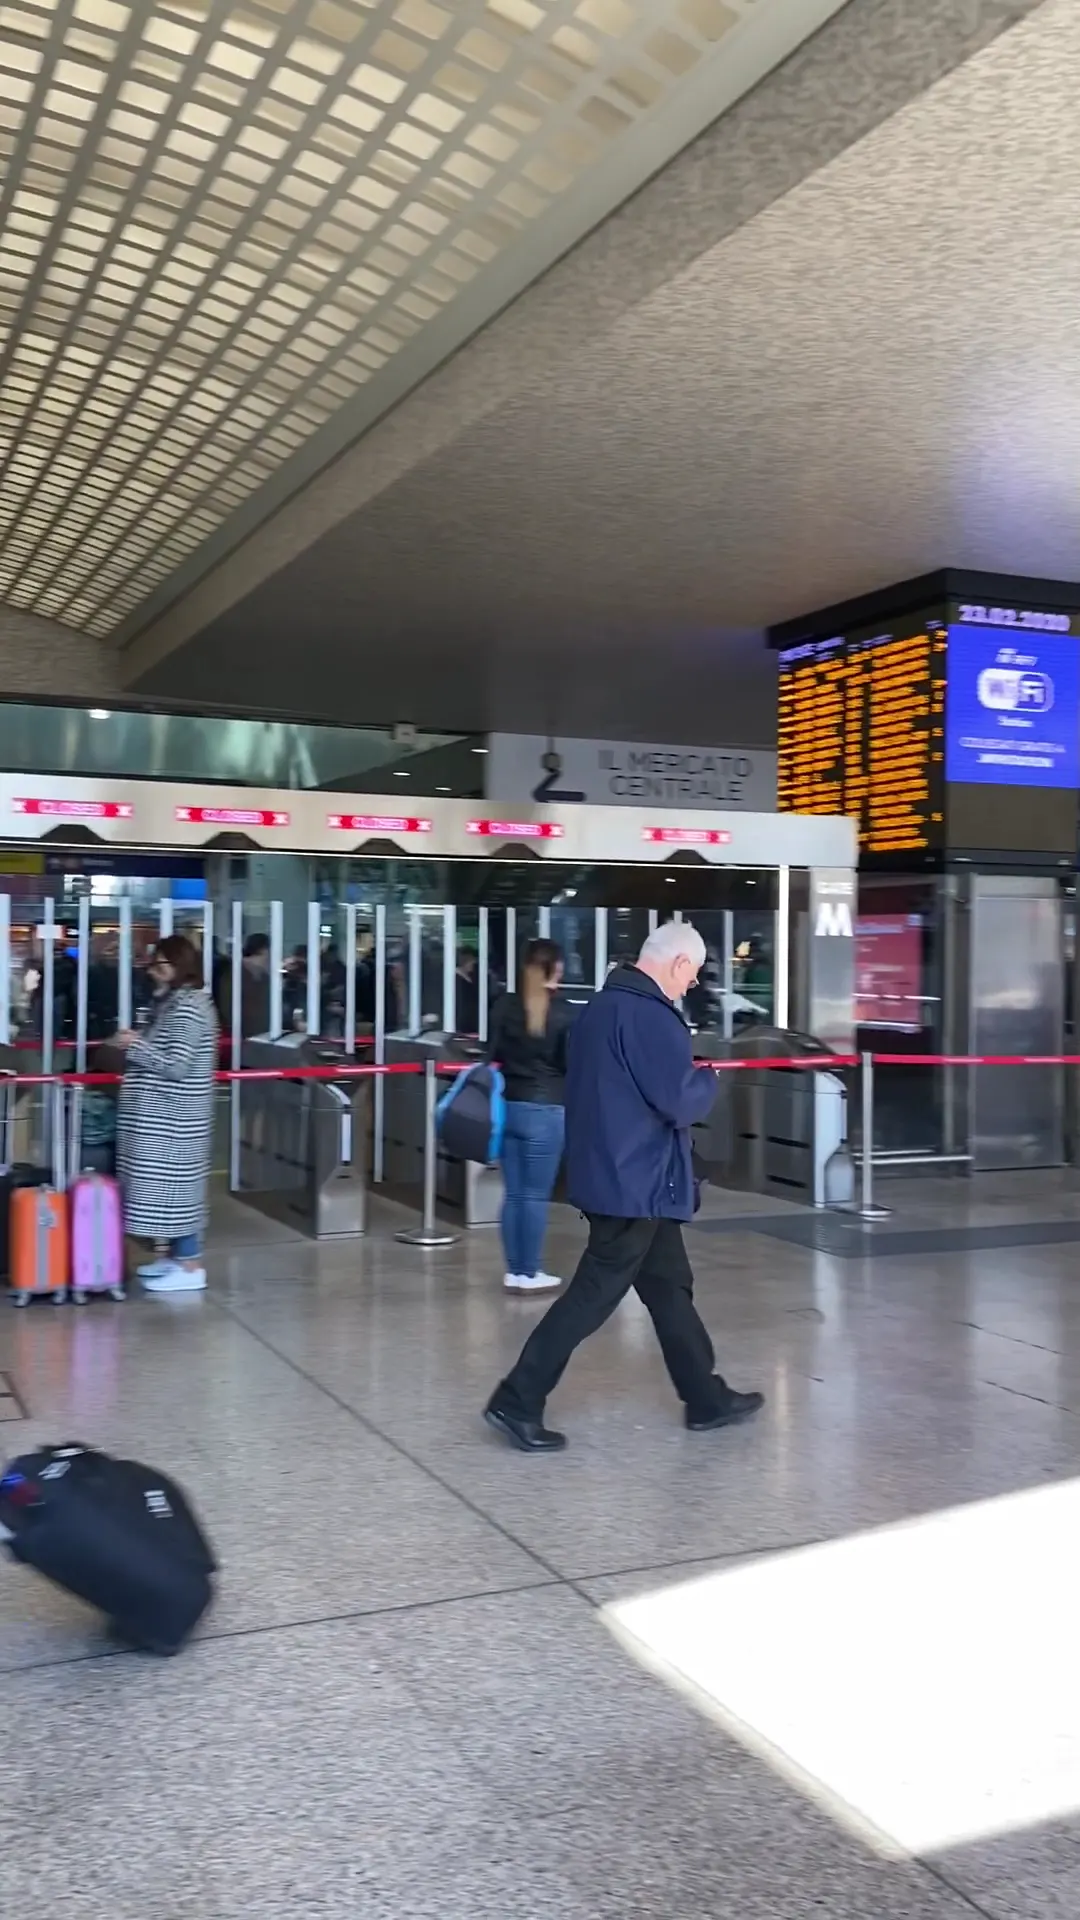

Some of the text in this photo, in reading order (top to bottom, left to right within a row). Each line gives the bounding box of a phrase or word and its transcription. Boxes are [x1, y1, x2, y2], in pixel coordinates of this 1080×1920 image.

[958, 604, 1071, 632] 23.02.2020
[598, 749, 754, 778] IL MERCATO
[609, 774, 744, 801] CENTRALE
[38, 800, 105, 817] CLOSED
[201, 808, 264, 824] CLOSED
[351, 816, 409, 830] CLOSED
[488, 822, 543, 837] CLOSED
[815, 902, 854, 937] M
